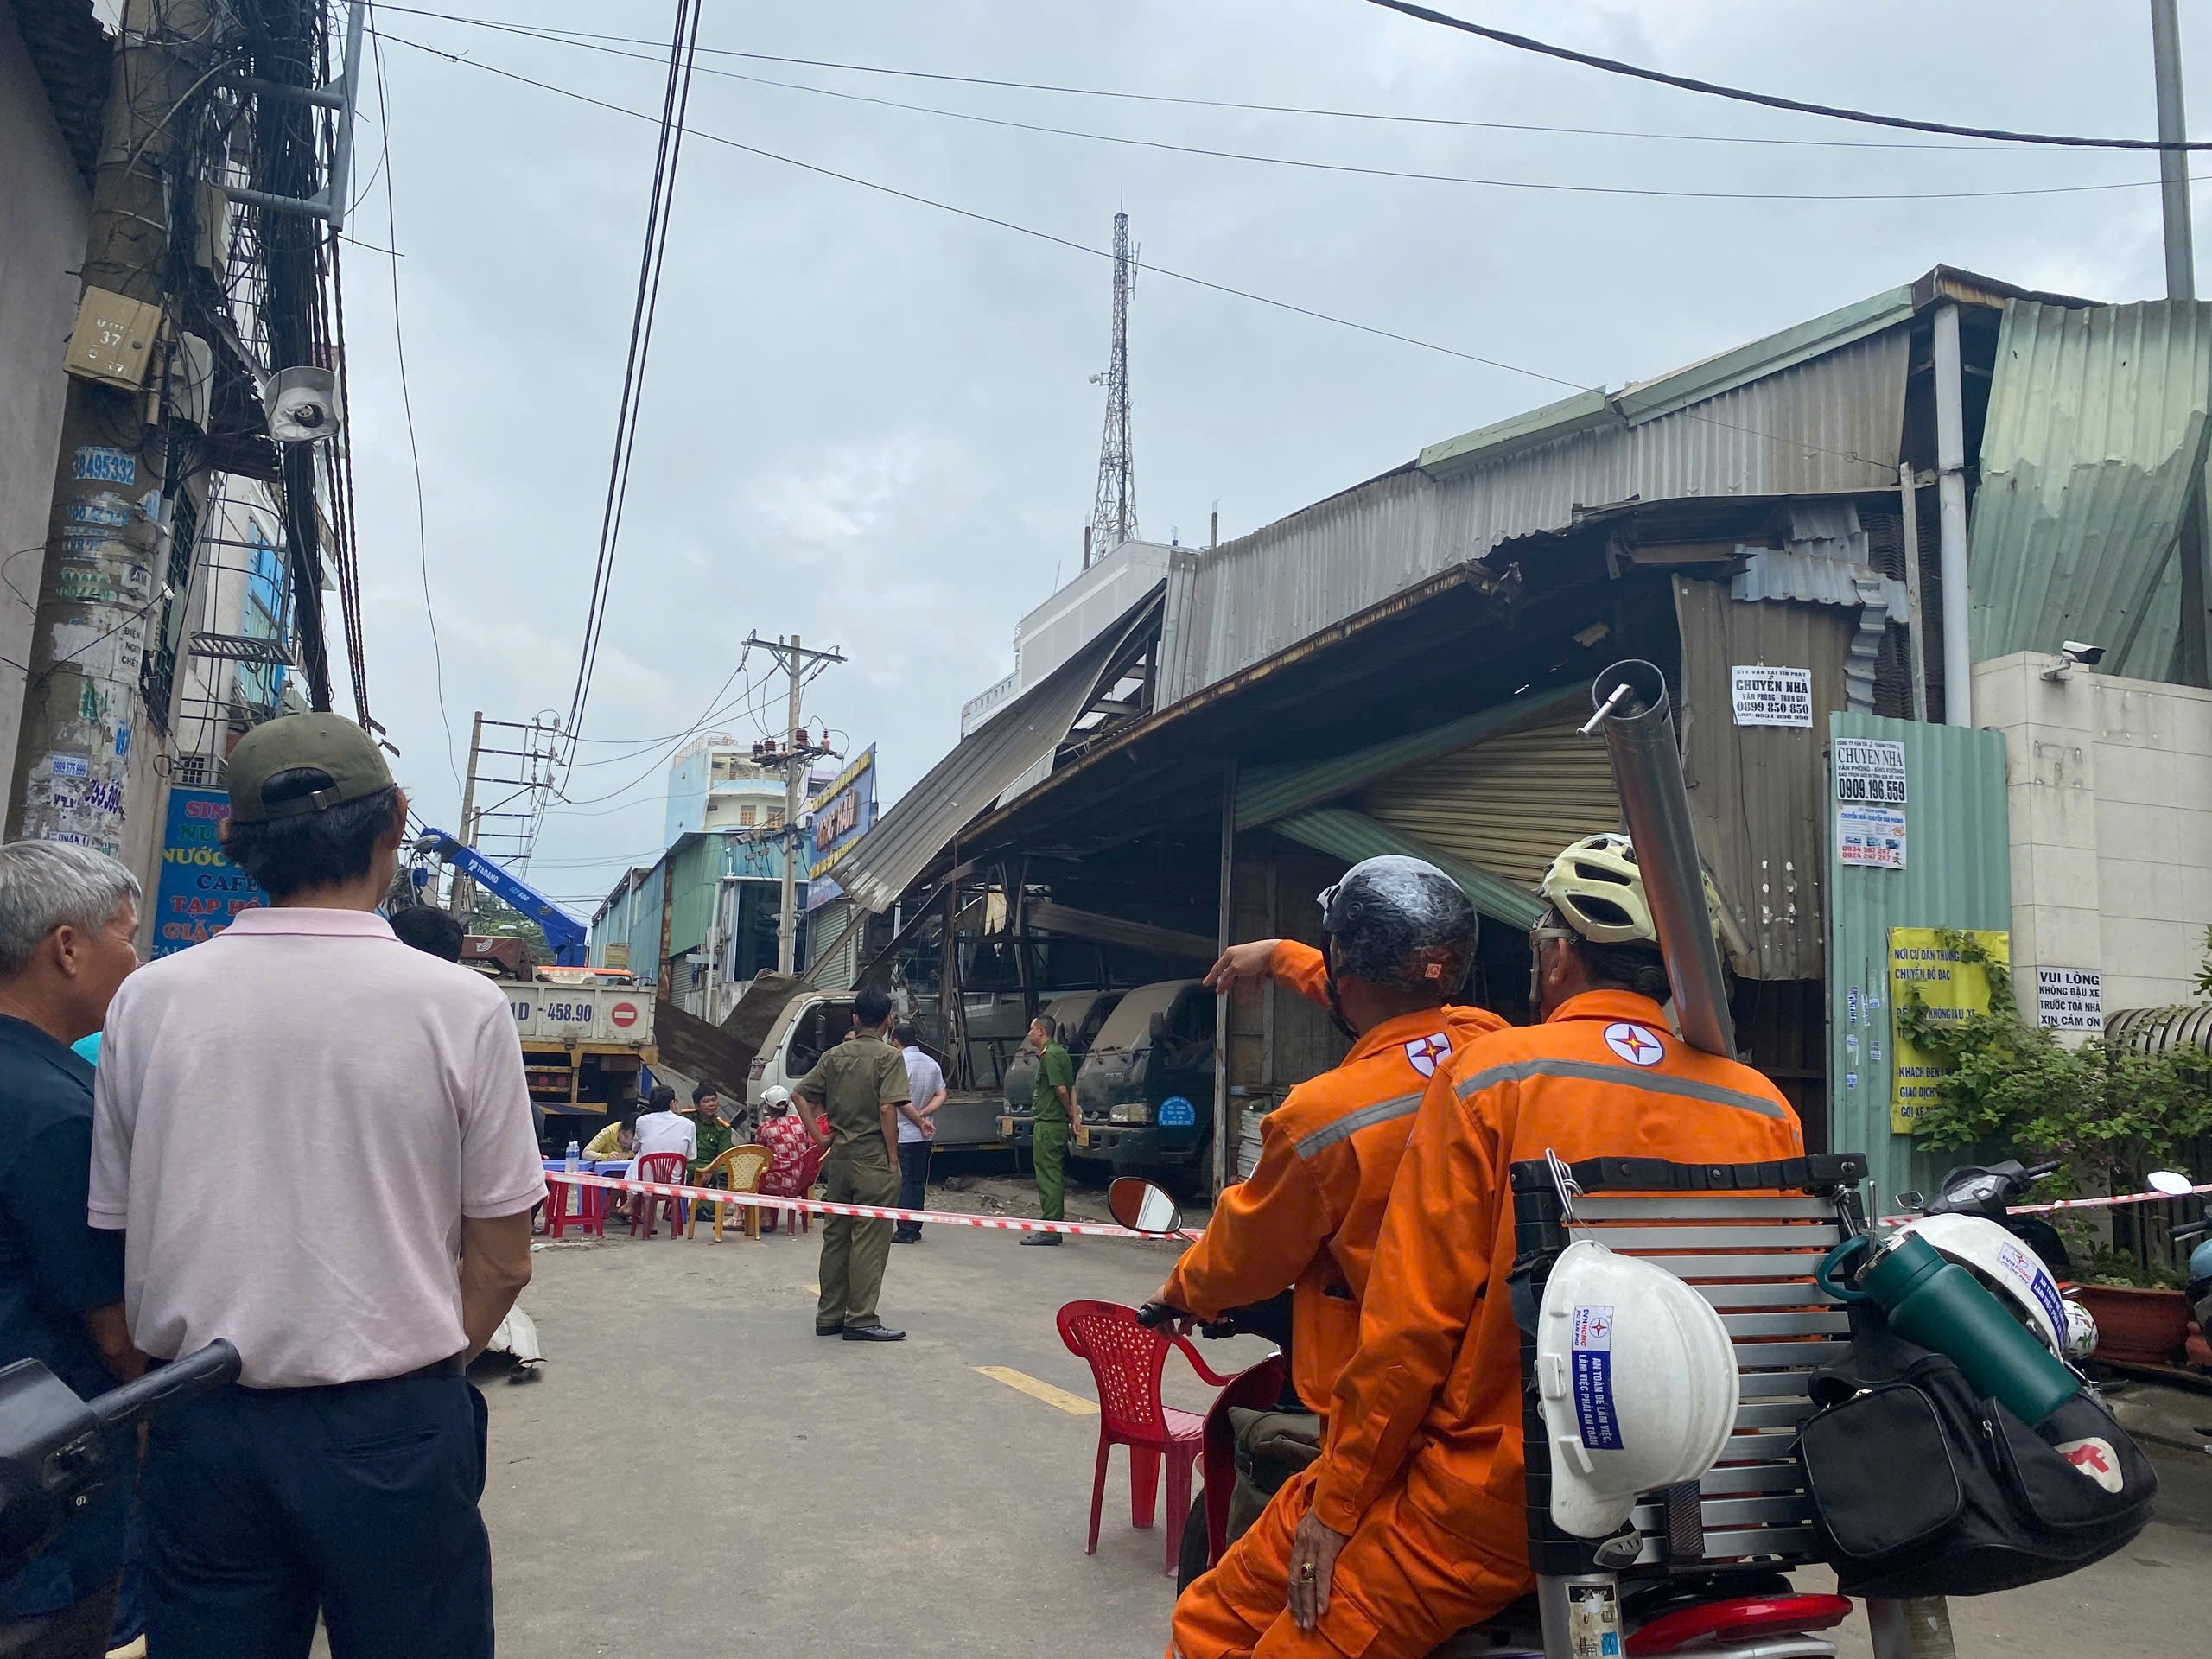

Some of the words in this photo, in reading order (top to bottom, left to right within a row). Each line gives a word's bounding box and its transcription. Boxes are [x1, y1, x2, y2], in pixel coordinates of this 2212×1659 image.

[1785, 679, 1808, 693] NHÀ
[1737, 702, 1764, 711] 0899
[1767, 702, 1786, 713] 850
[1789, 703, 1808, 714] 850
[1882, 747, 1903, 766] NHÀ
[1839, 778, 1904, 801] 0909.196.559
[185, 801, 233, 819] SIN
[477, 864, 499, 883] TADANO
[170, 895, 221, 918] TẠP
[227, 897, 270, 917] HÓ
[2040, 971, 2061, 983] VUI
[2066, 971, 2100, 985] LÒNG
[2039, 984, 2068, 995] KHÔNG
[2070, 986, 2087, 998] ĐẬU
[2089, 988, 2100, 997] XE
[547, 1003, 592, 1022] 458.90
[2040, 998, 2066, 1010] TRƯỚC
[2085, 1001, 2101, 1013] NHÀ
[2041, 1015, 2057, 1024] XIN
[2061, 1014, 2083, 1026] CẢM
[1900, 1087, 1916, 1097] GIAO
[1579, 1354, 1588, 1372] LÀM
[1592, 1357, 1601, 1370] AN
[1583, 1413, 1594, 1425] AN
